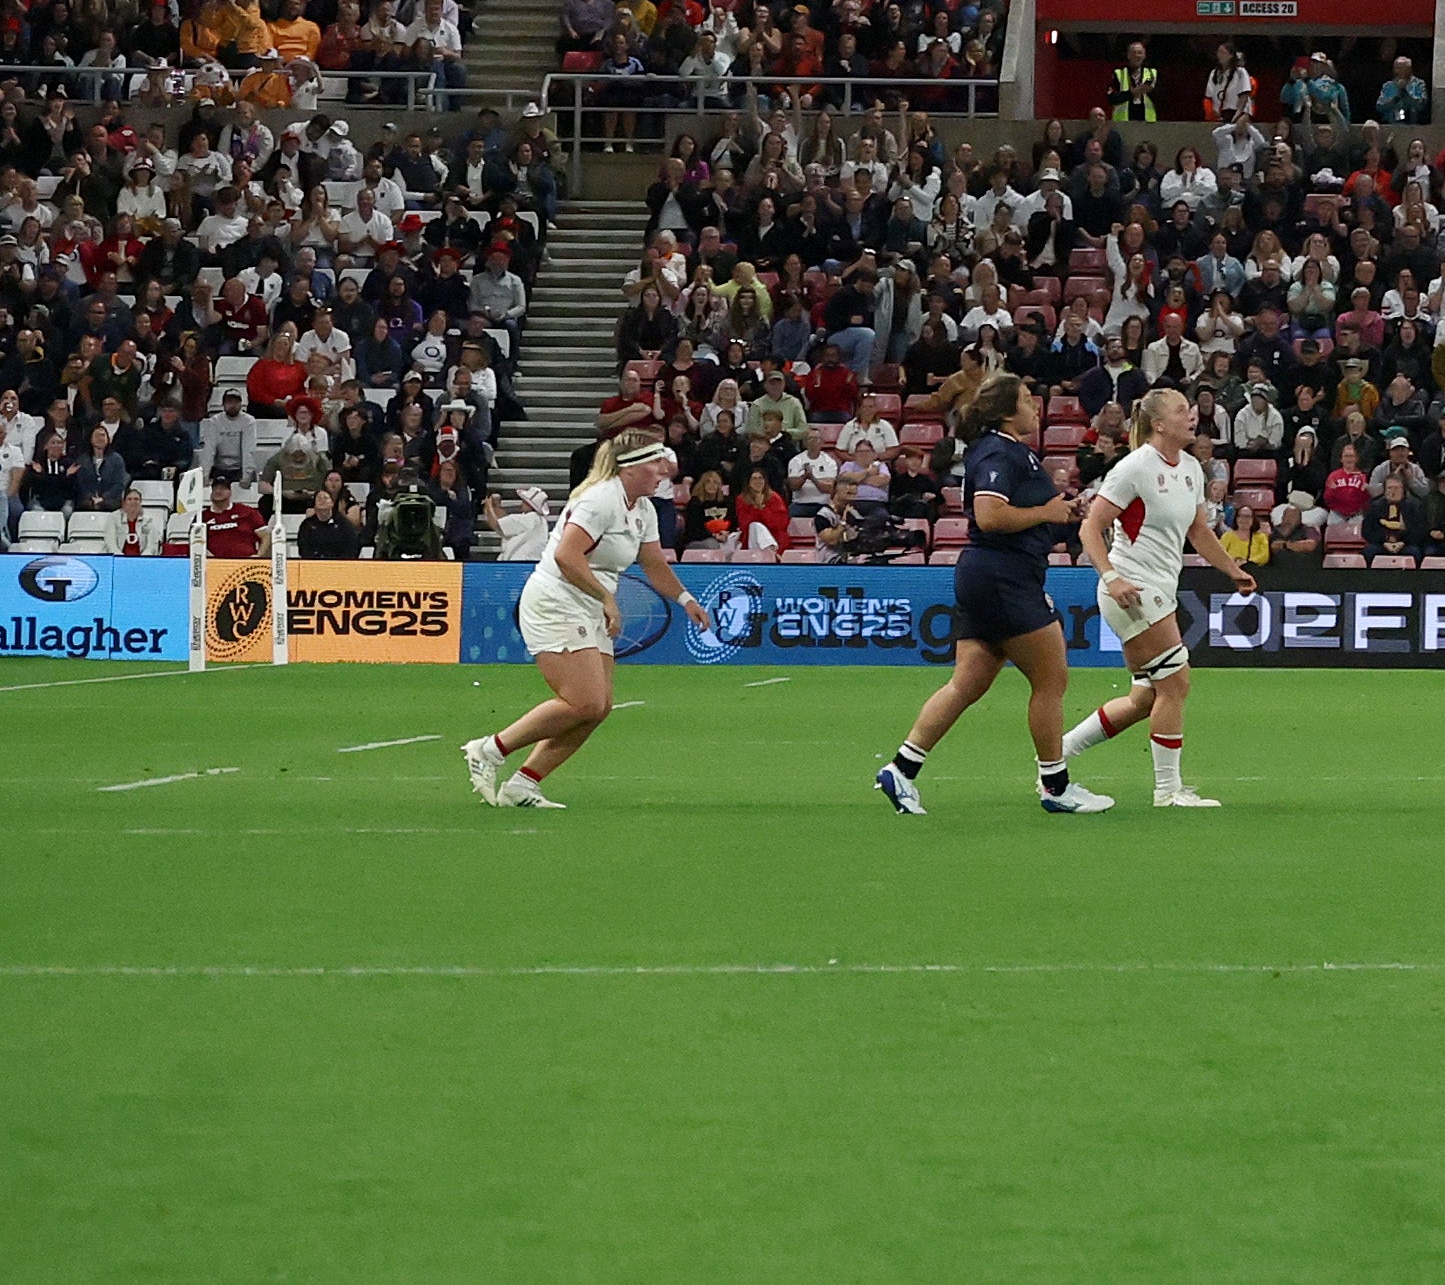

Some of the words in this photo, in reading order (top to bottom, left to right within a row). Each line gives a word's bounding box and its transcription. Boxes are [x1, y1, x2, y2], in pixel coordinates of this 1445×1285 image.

[1242, 2, 1280, 15] ACCESS
[1281, 3, 1294, 15] 20
[287, 589, 449, 610] WOMEN'S
[775, 597, 912, 615] WOMEN'S
[287, 609, 449, 637] ENG25
[777, 614, 913, 639] ENG25
[0, 616, 168, 659] llagher
